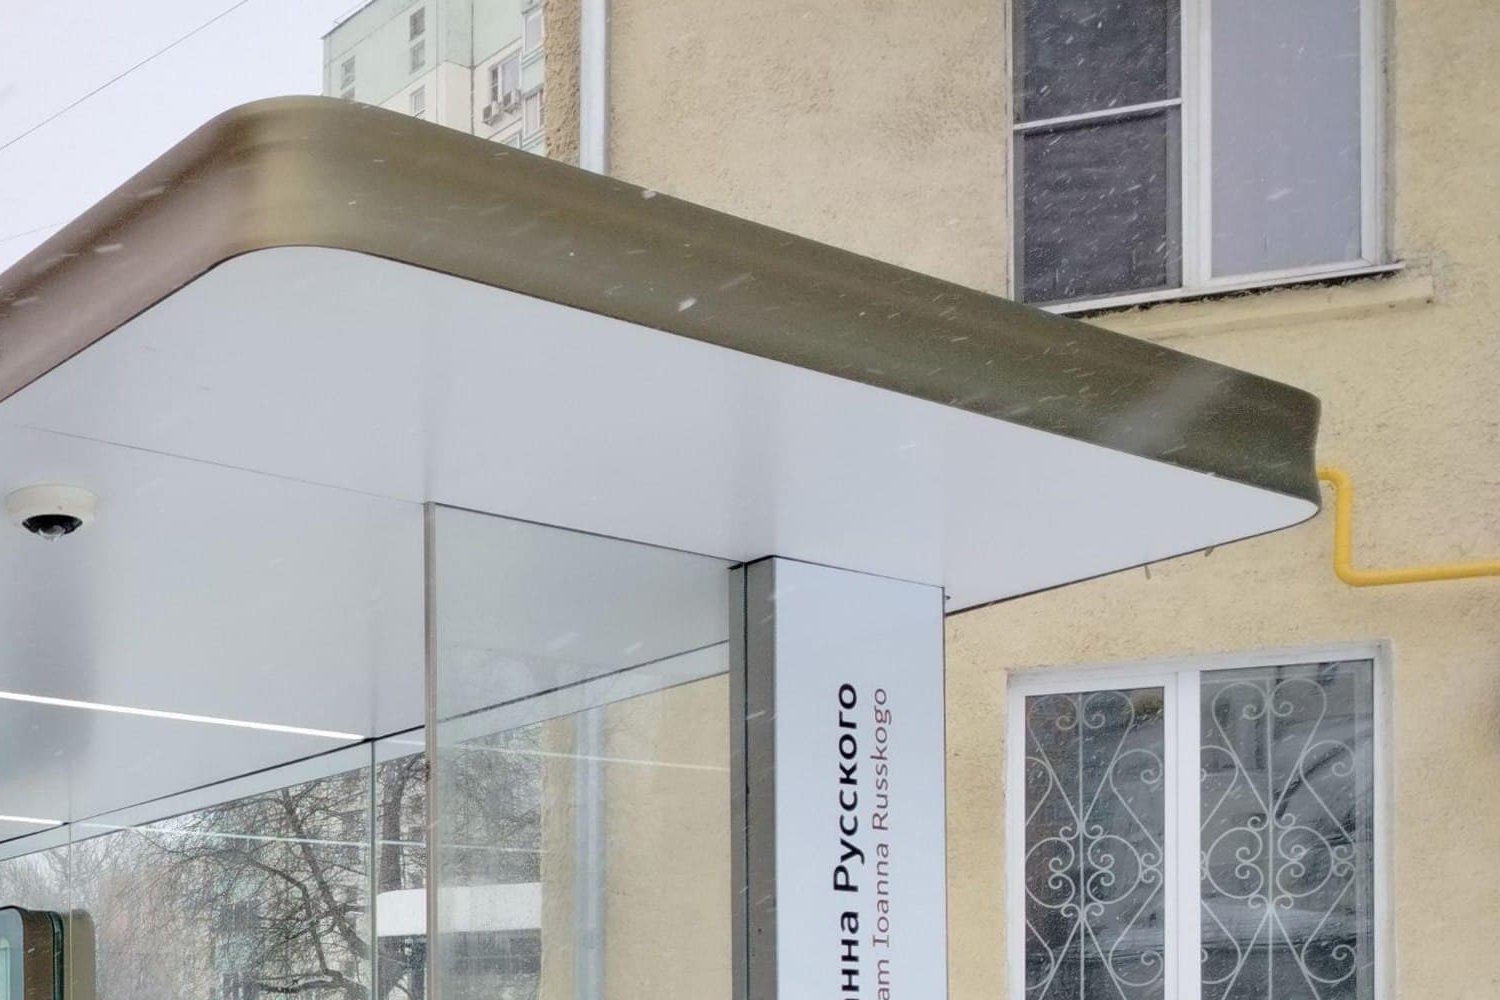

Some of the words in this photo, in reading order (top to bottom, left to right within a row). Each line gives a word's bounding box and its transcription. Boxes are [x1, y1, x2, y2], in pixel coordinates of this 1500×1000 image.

[832, 683, 865, 893] Русского
[870, 688, 893, 831] Russkogo
[872, 842, 890, 948] Ioanna
